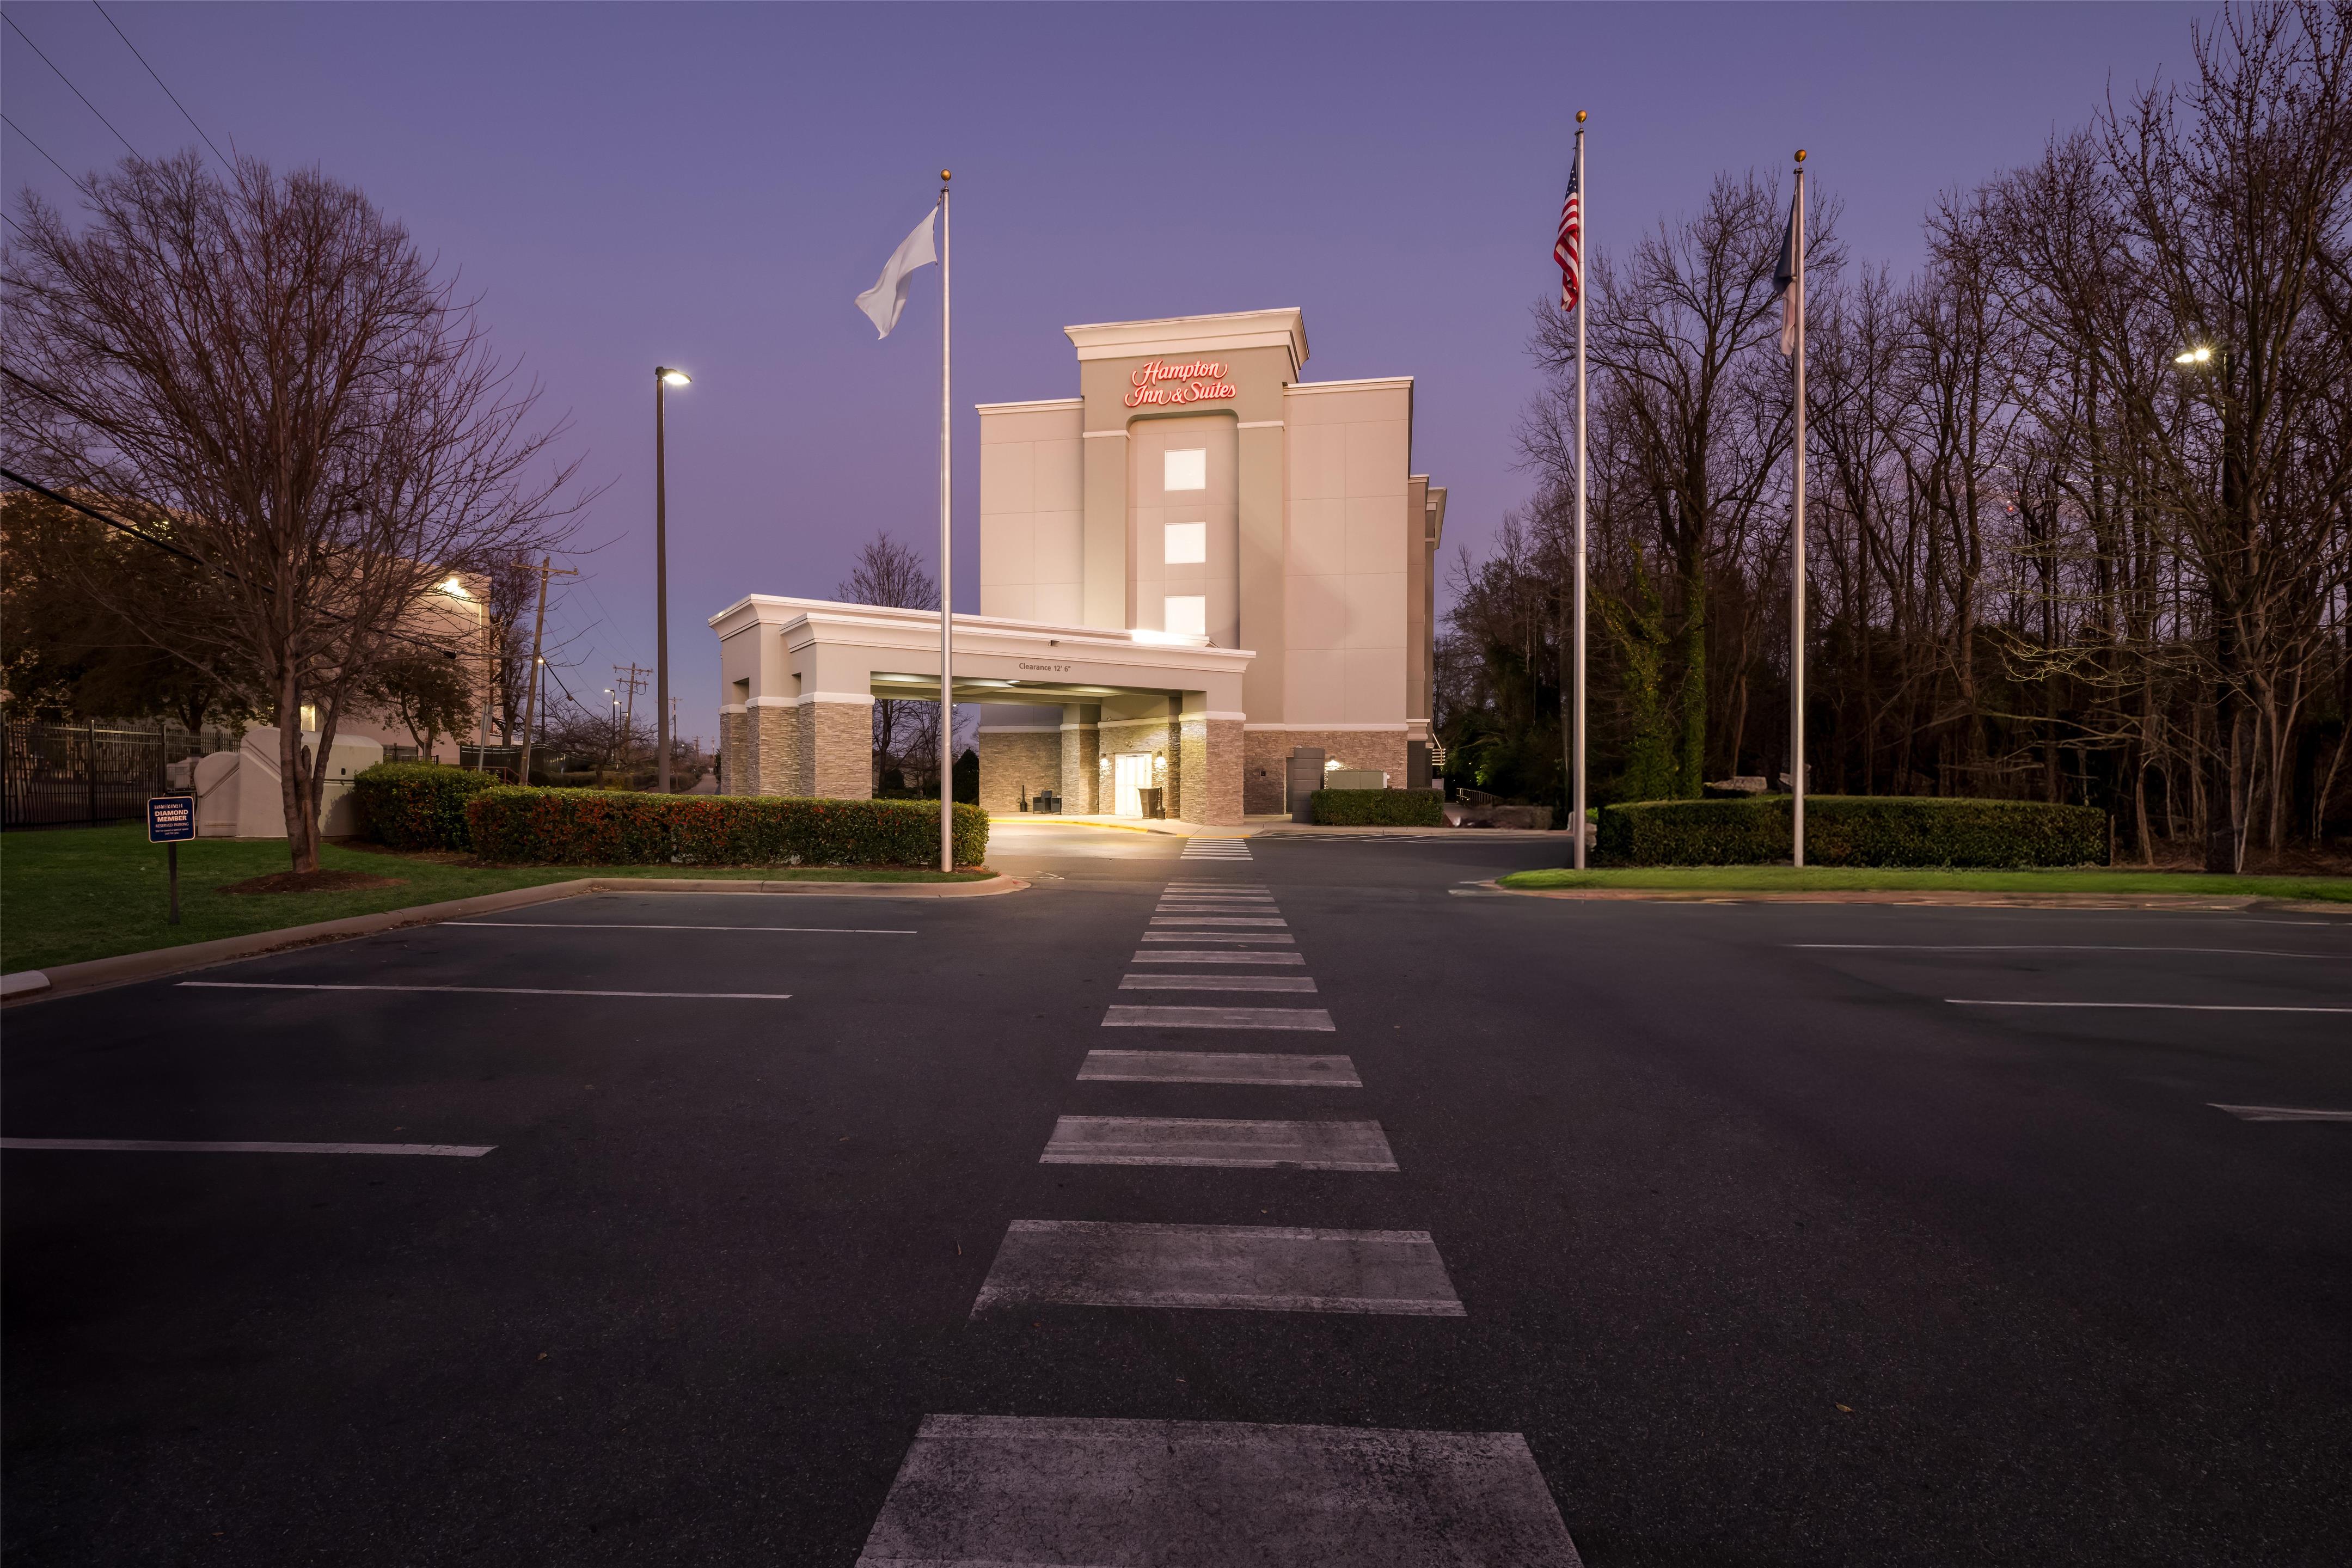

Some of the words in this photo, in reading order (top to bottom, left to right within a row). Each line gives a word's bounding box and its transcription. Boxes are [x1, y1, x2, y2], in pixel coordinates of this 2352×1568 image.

[1132, 360, 1228, 387] Hampton
[1124, 385, 1172, 407] Inn
[1171, 388, 1186, 404] &
[1184, 382, 1236, 402] Suites
[1019, 663, 1051, 671] Clearance
